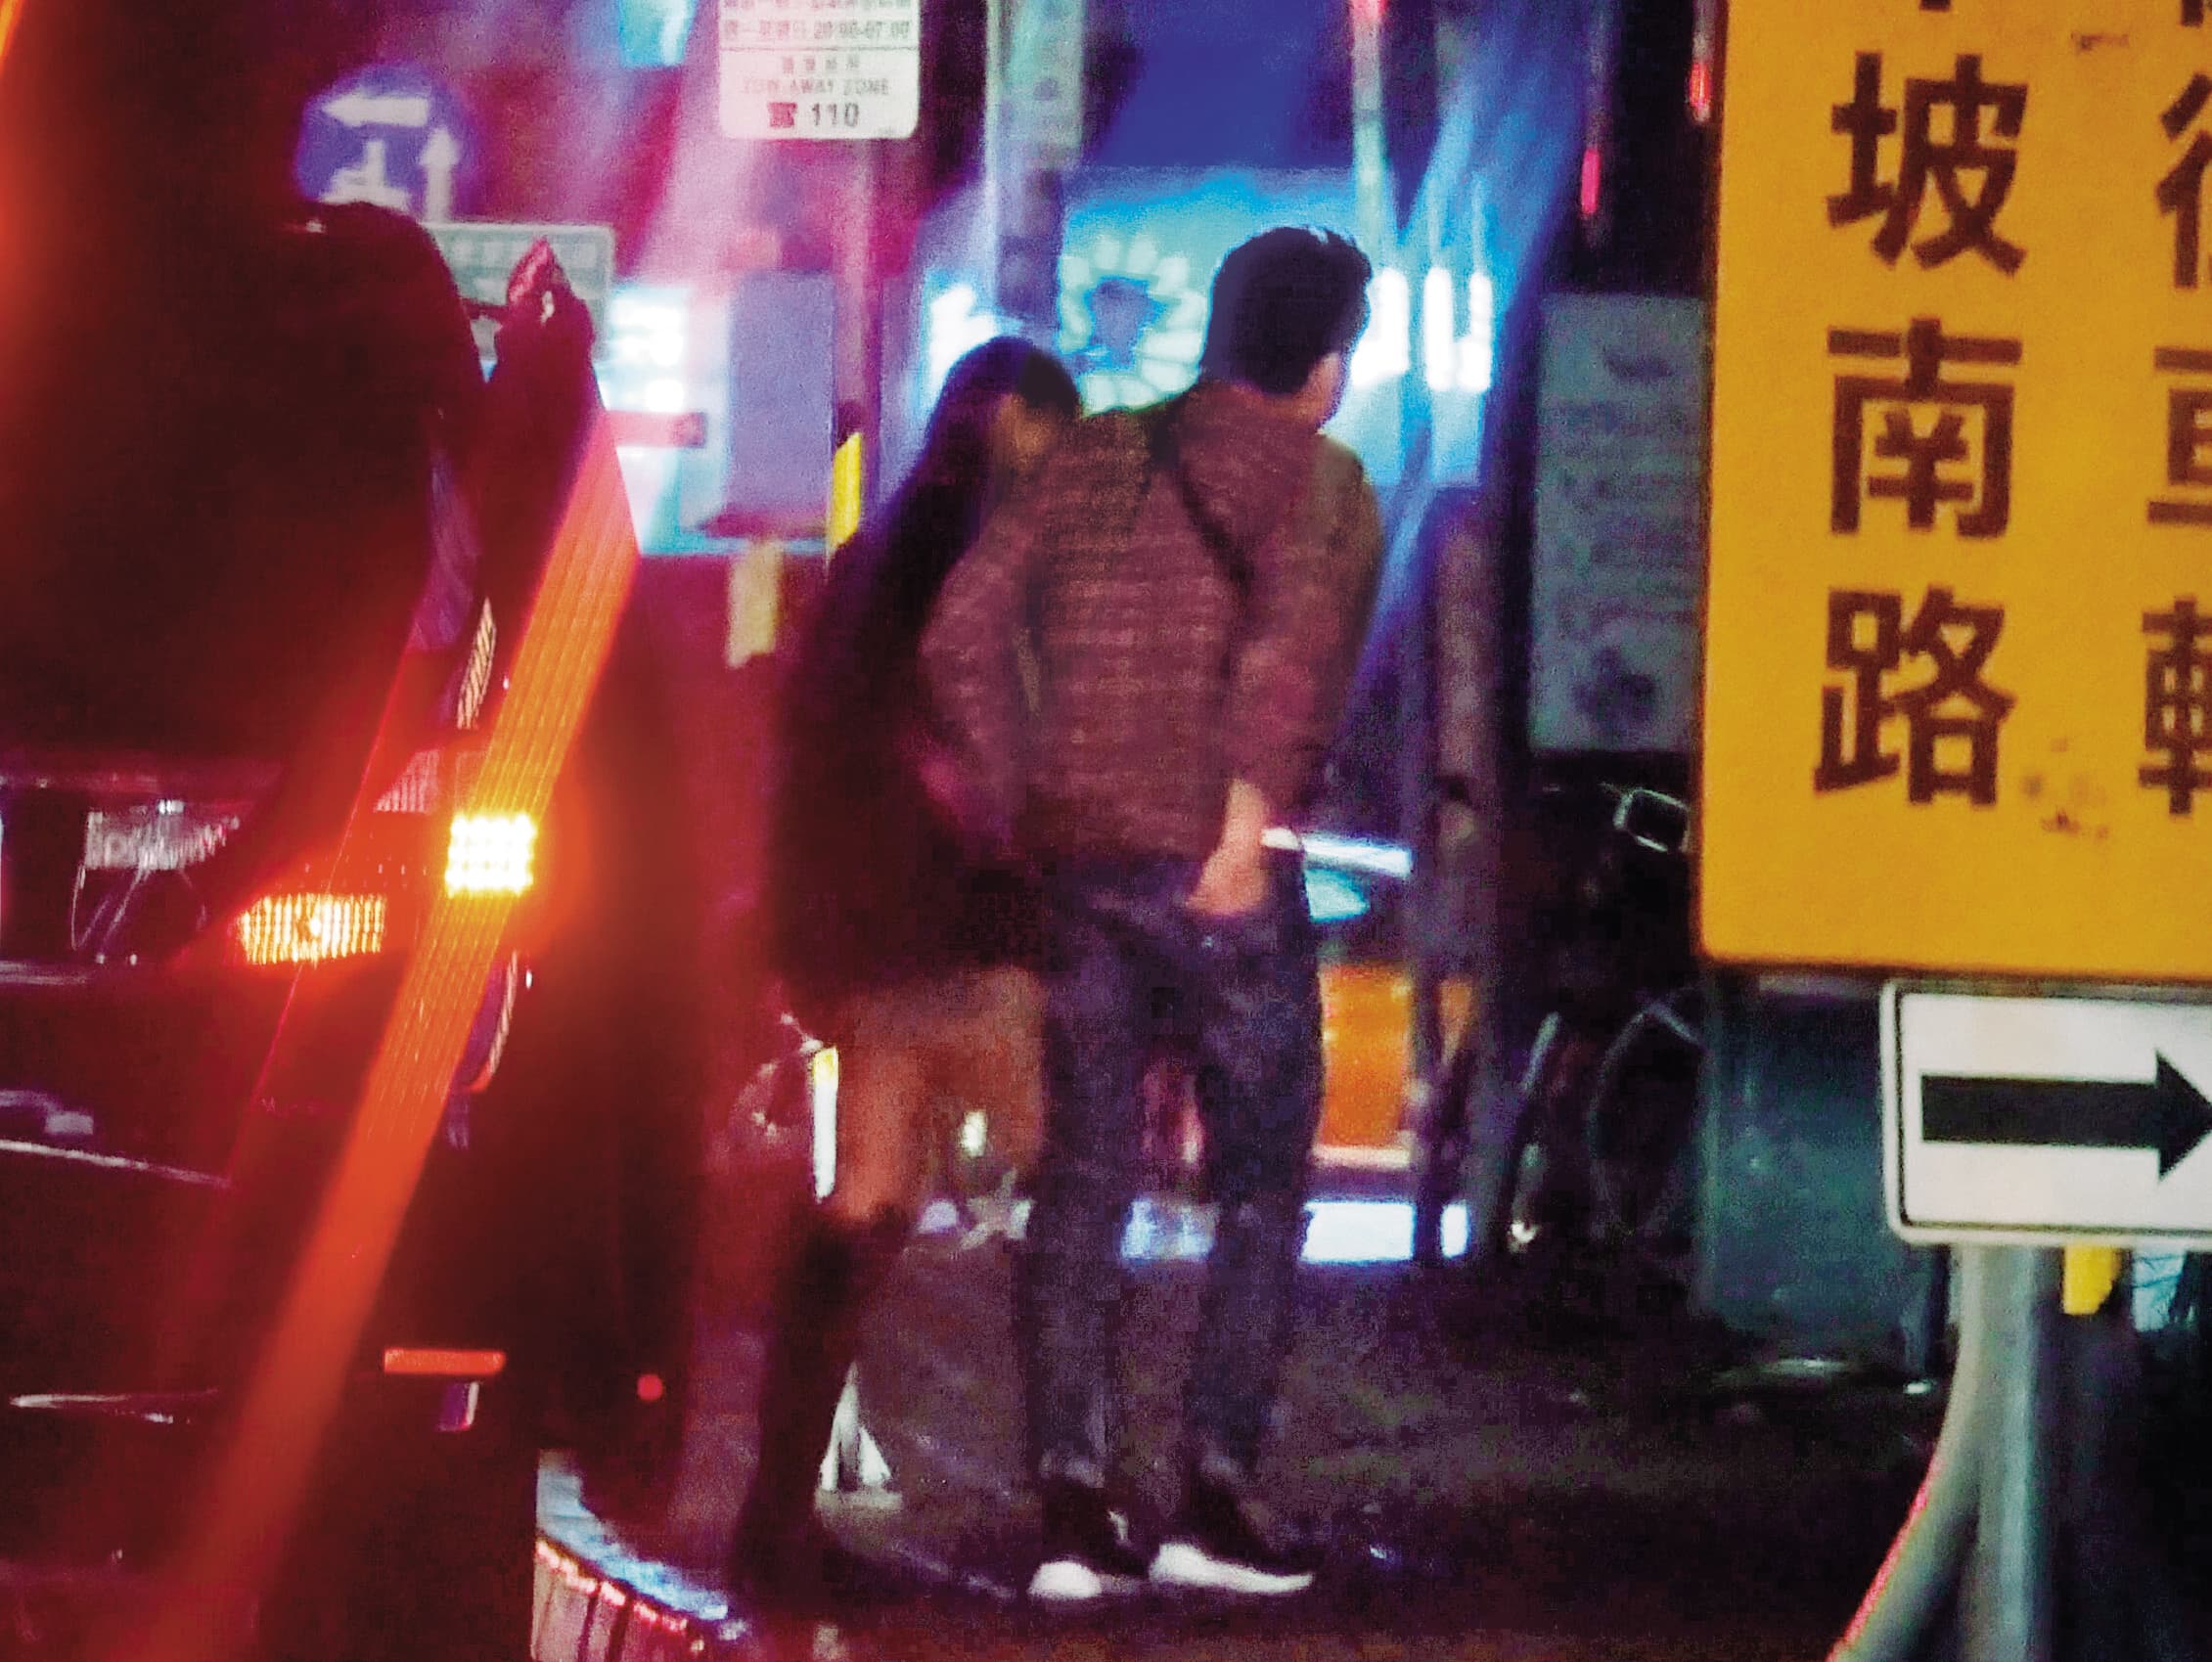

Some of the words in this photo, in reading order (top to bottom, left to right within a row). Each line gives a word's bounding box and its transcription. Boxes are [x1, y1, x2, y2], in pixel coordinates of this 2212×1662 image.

[790, 78, 834, 94] AWAY
[843, 78, 889, 96] ZONE
[811, 102, 860, 128] 110
[1815, 0, 2029, 807] 坡南路
